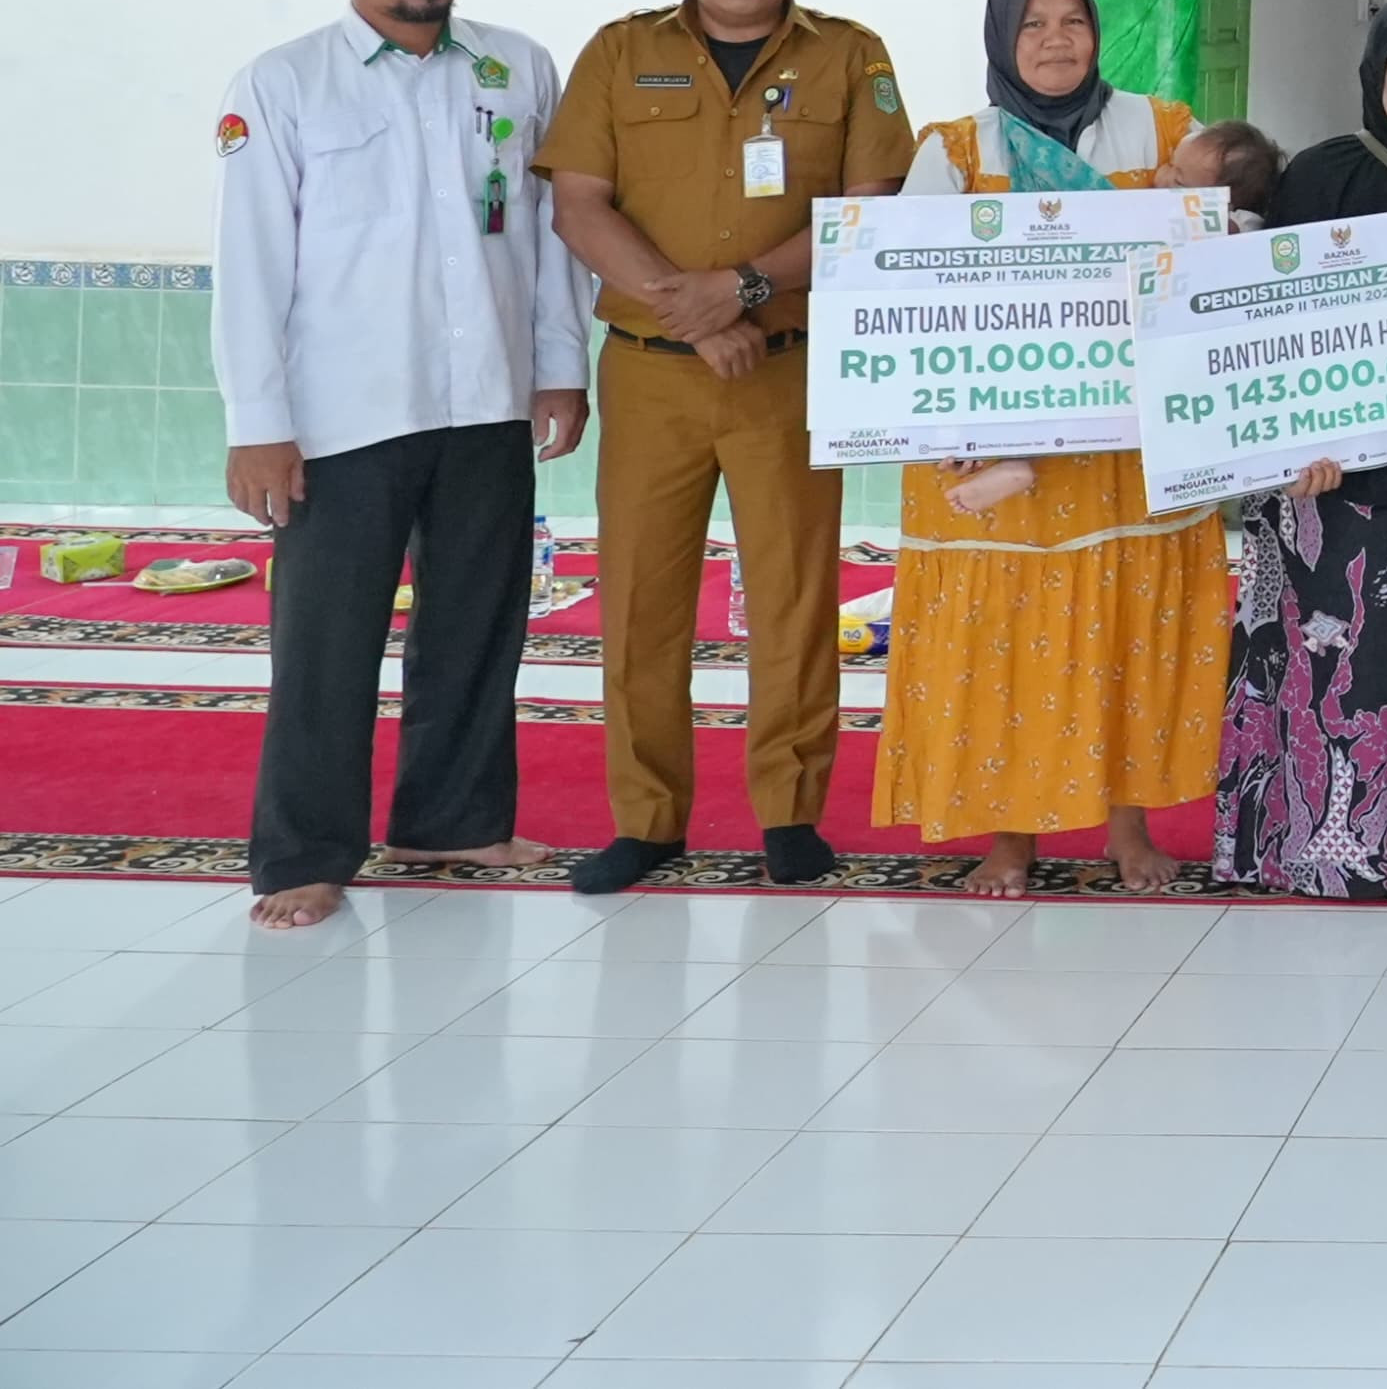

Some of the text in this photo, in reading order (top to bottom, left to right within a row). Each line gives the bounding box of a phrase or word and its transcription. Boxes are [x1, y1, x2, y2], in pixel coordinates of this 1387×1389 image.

[1029, 223, 1071, 231] BAZNAS
[883, 244, 1133, 268] PENDISTRIBUSIAN ZAK
[936, 266, 1112, 285] TAHAP II TAHUN 2026
[1200, 270, 1373, 311] PENDISTRIBUSIAN
[854, 299, 1131, 336] BANTUAN USAHA PRODU
[1245, 302, 1294, 321] TAHAP
[1299, 301, 1308, 313] II
[1311, 294, 1361, 311] TAHUN
[1208, 333, 1305, 376] BANTUAN
[1311, 320, 1373, 357] BIAYA
[839, 338, 1136, 383] Rp 101.000.00
[912, 379, 1134, 415] 25 Mustahik
[1164, 391, 1215, 426] Rp
[828, 437, 910, 449] MENGUATKAN
[849, 429, 888, 439] ZAKAT
[1226, 416, 1280, 449] 143
[836, 447, 901, 458] INDONESIA
[1164, 473, 1235, 494] MENGUATKAN
[1183, 467, 1216, 481] ZAKAT
[1172, 483, 1228, 501] INDONESIA
